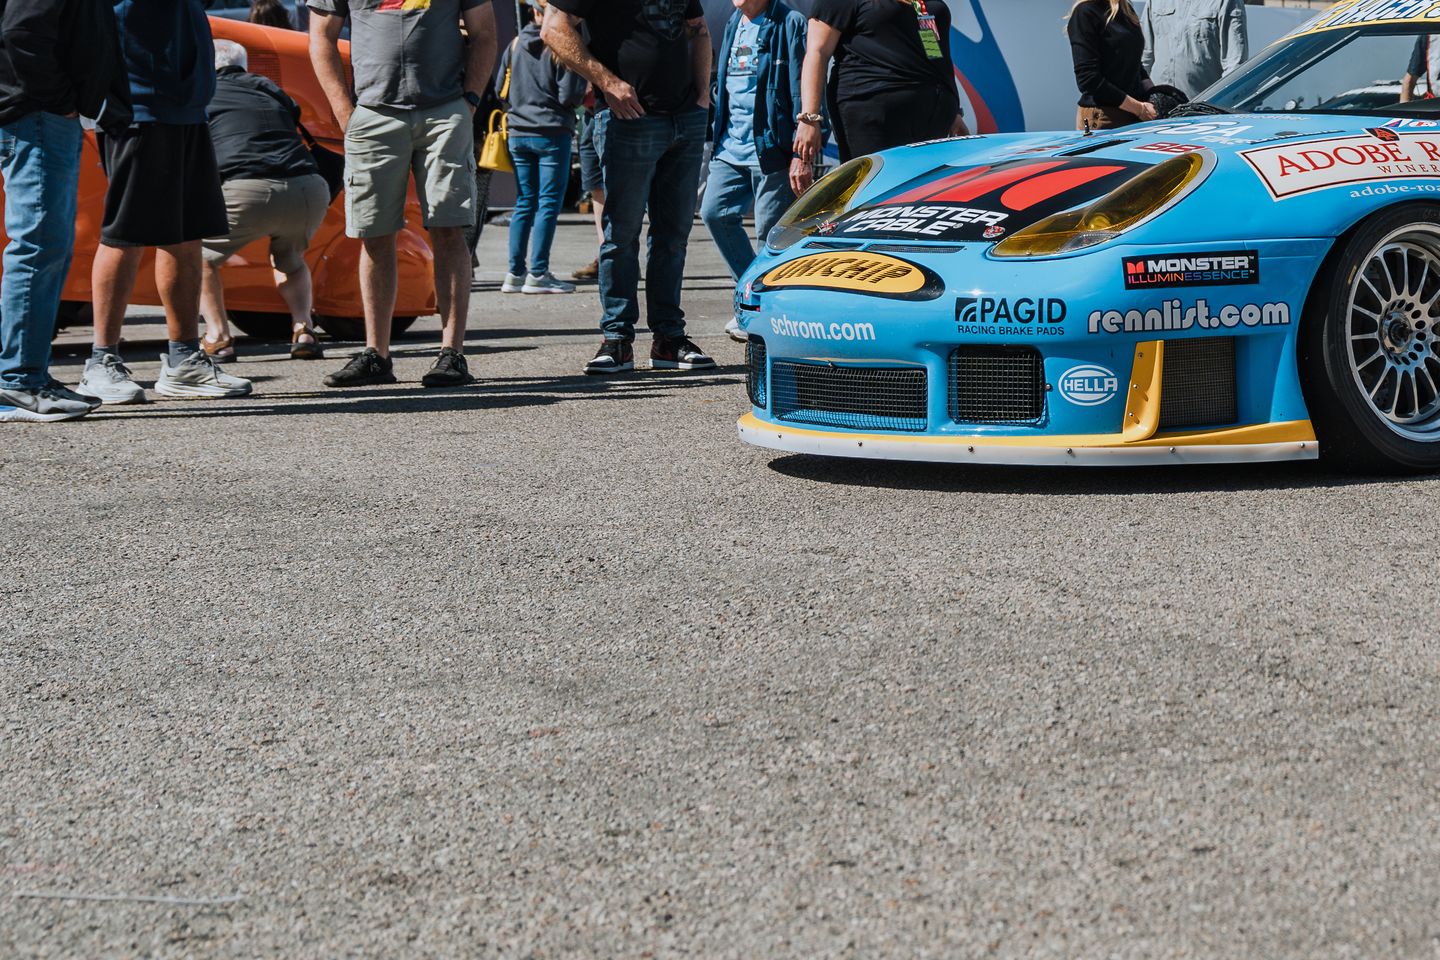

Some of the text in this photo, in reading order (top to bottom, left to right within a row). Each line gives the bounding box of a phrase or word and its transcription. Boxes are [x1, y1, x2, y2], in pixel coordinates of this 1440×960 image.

[1278, 142, 1411, 178] ADOBE
[844, 206, 1010, 227] MONSTER
[771, 257, 913, 284] UNICHIP
[980, 297, 1067, 324] PAGID
[1087, 299, 1292, 335] rennlist.com
[770, 314, 876, 340] schrom.com
[957, 325, 1065, 336] RACING BRAKE PADS
[1063, 377, 1118, 393] HELLA
